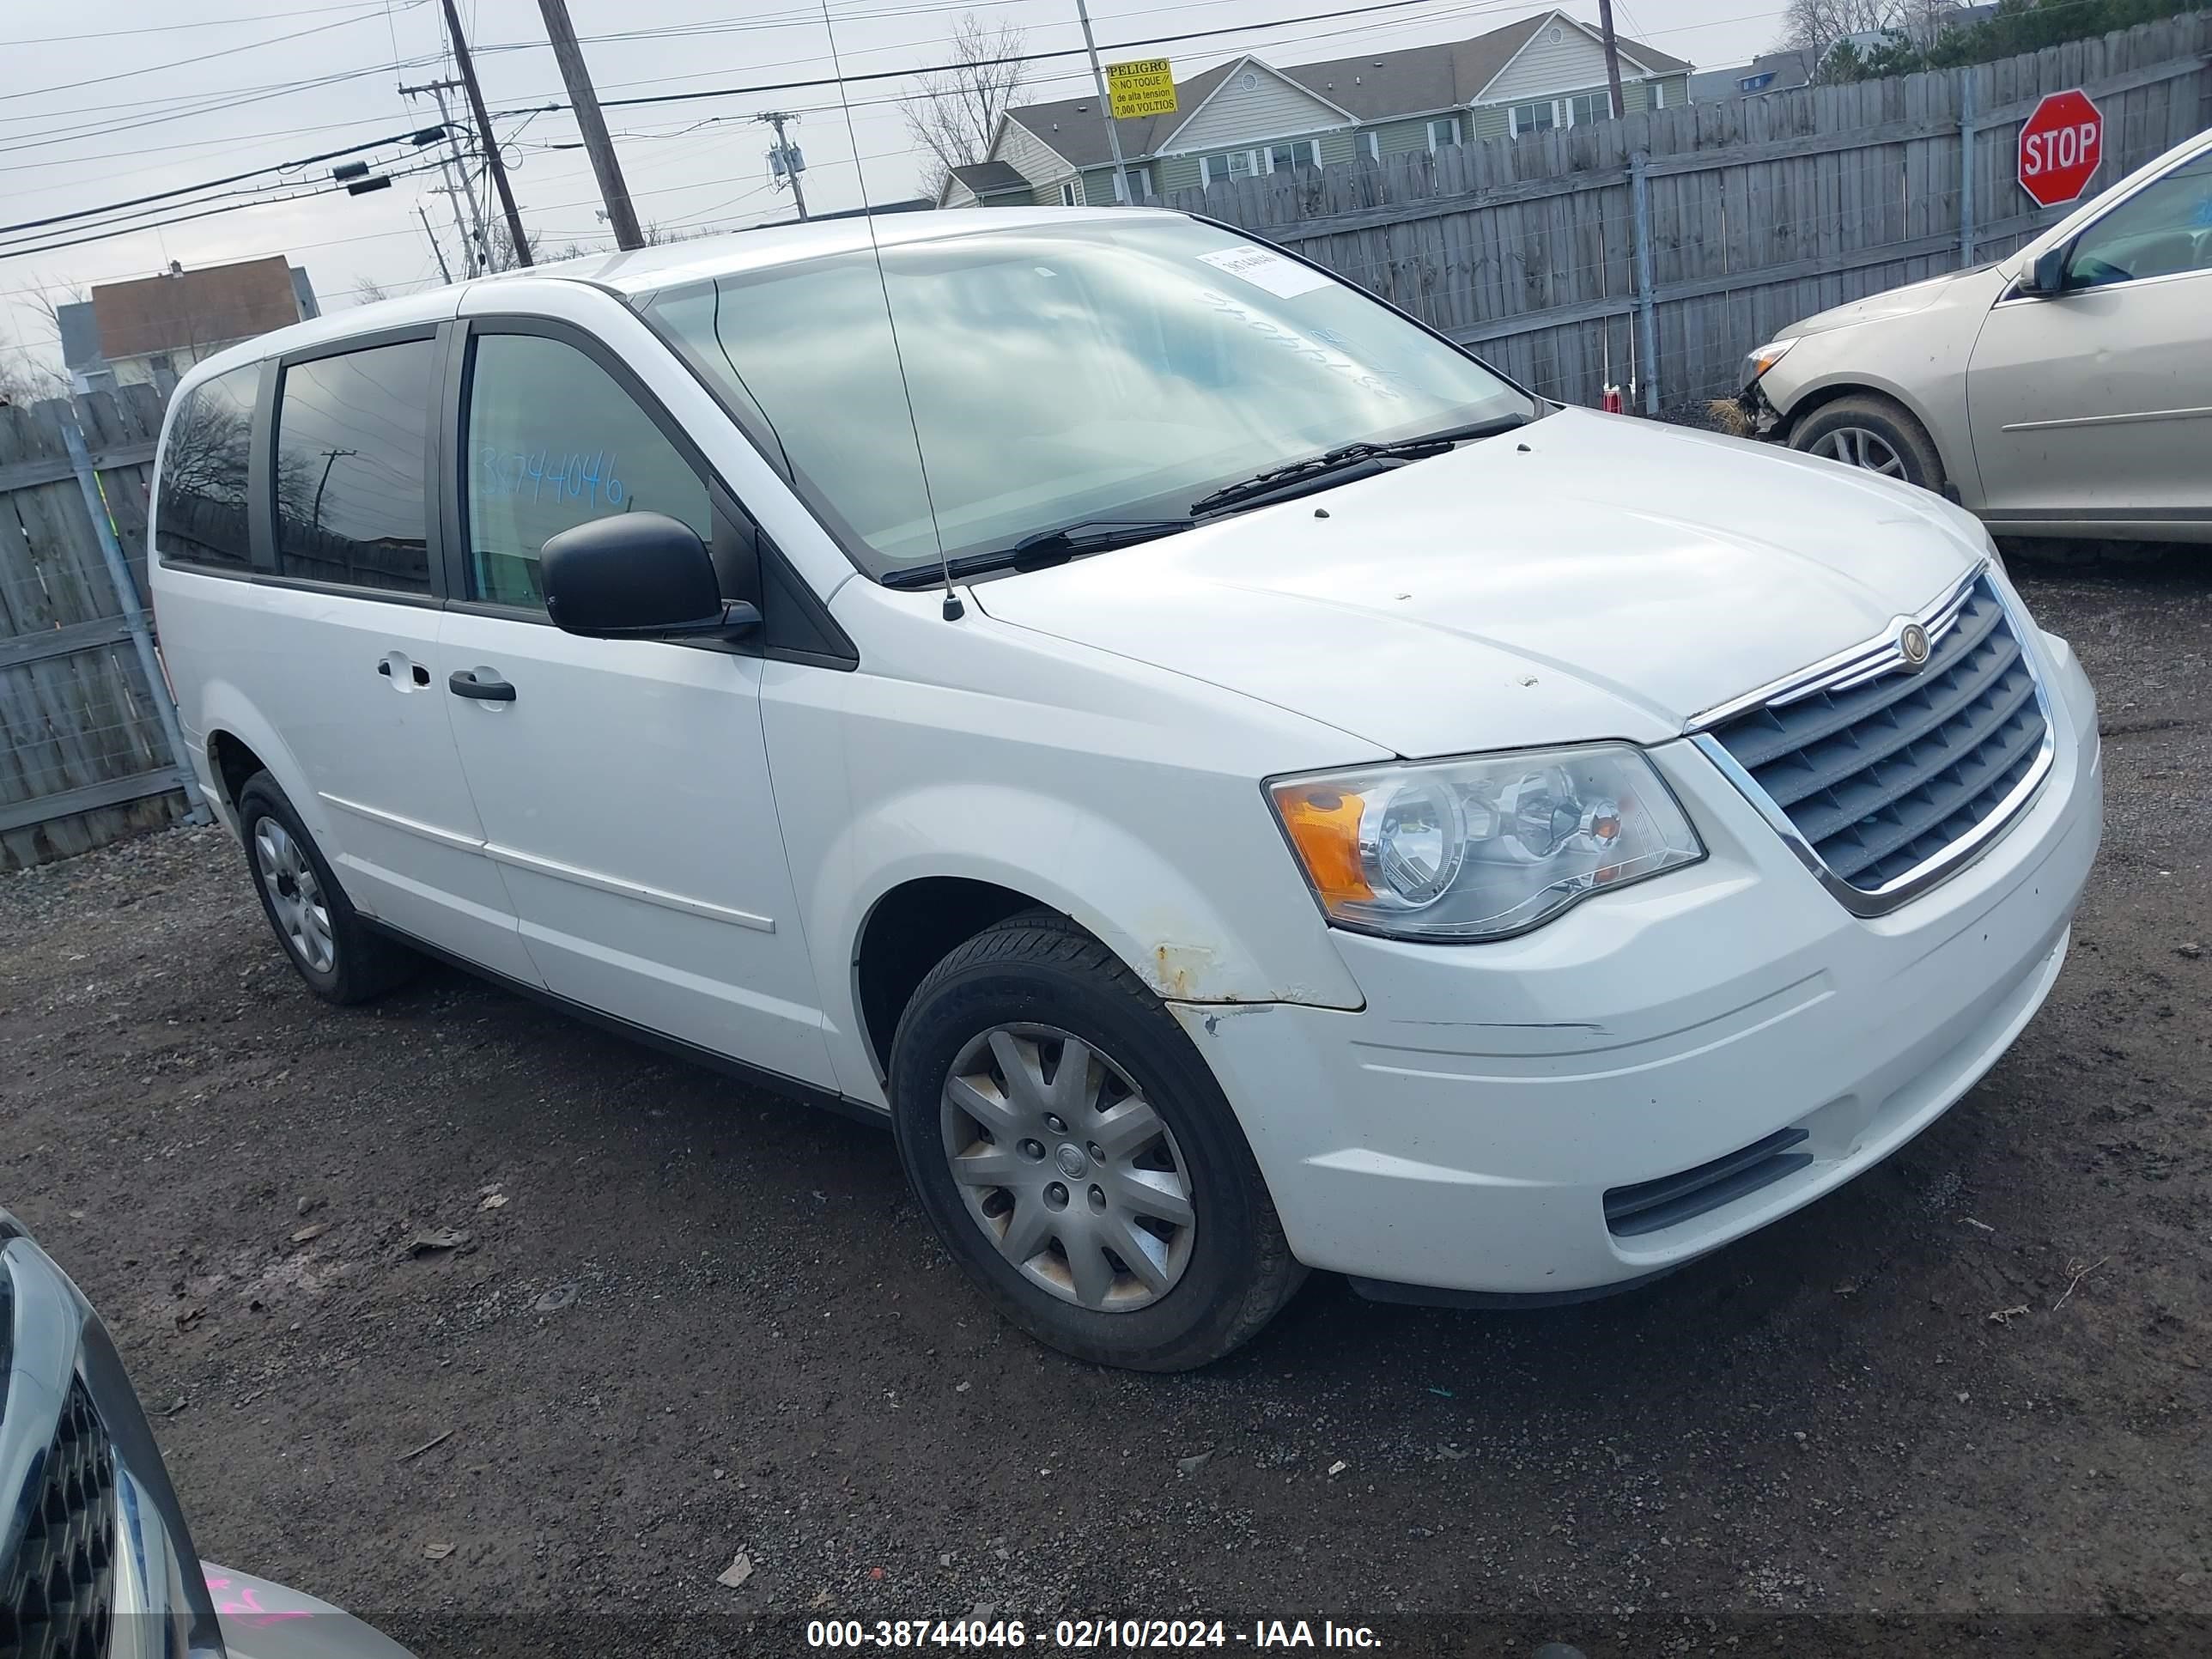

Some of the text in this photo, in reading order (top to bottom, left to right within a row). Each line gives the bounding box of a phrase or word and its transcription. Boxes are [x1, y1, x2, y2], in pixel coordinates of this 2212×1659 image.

[1110, 61, 1168, 76] PELIGRO
[1120, 76, 1161, 89] NO TOQUE
[1117, 88, 1170, 102] de alta tension
[1115, 99, 1175, 117] 7,000 VOLTIOS
[2025, 122, 2097, 175] STOP
